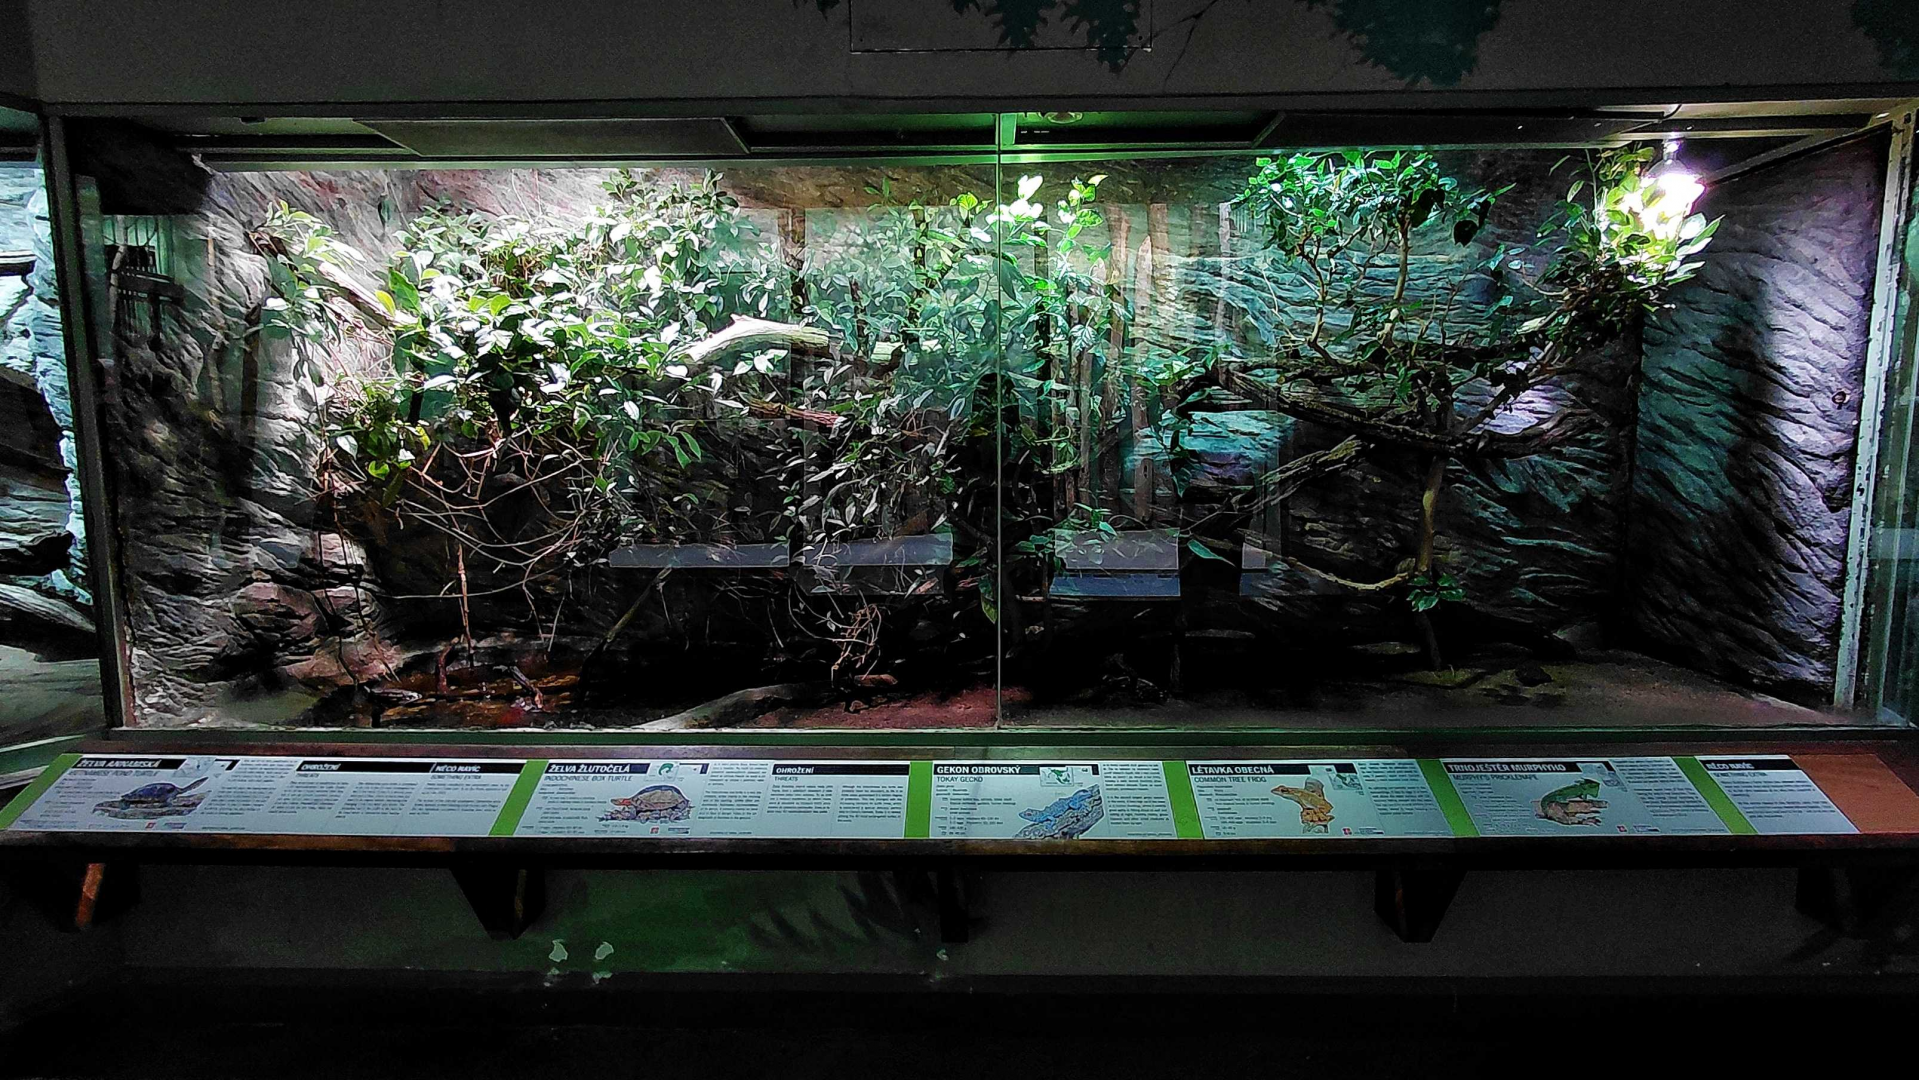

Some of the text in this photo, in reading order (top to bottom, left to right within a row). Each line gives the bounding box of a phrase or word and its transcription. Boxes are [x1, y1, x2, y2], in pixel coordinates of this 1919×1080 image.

[548, 763, 631, 774] ŽELVA ŽLUTOČELÁ
[776, 766, 814, 774] OHROŽENÍ
[936, 764, 1021, 774] GEKON OBROVSKÝ
[1191, 764, 1275, 774] LÉTAVKA OBECNÁ
